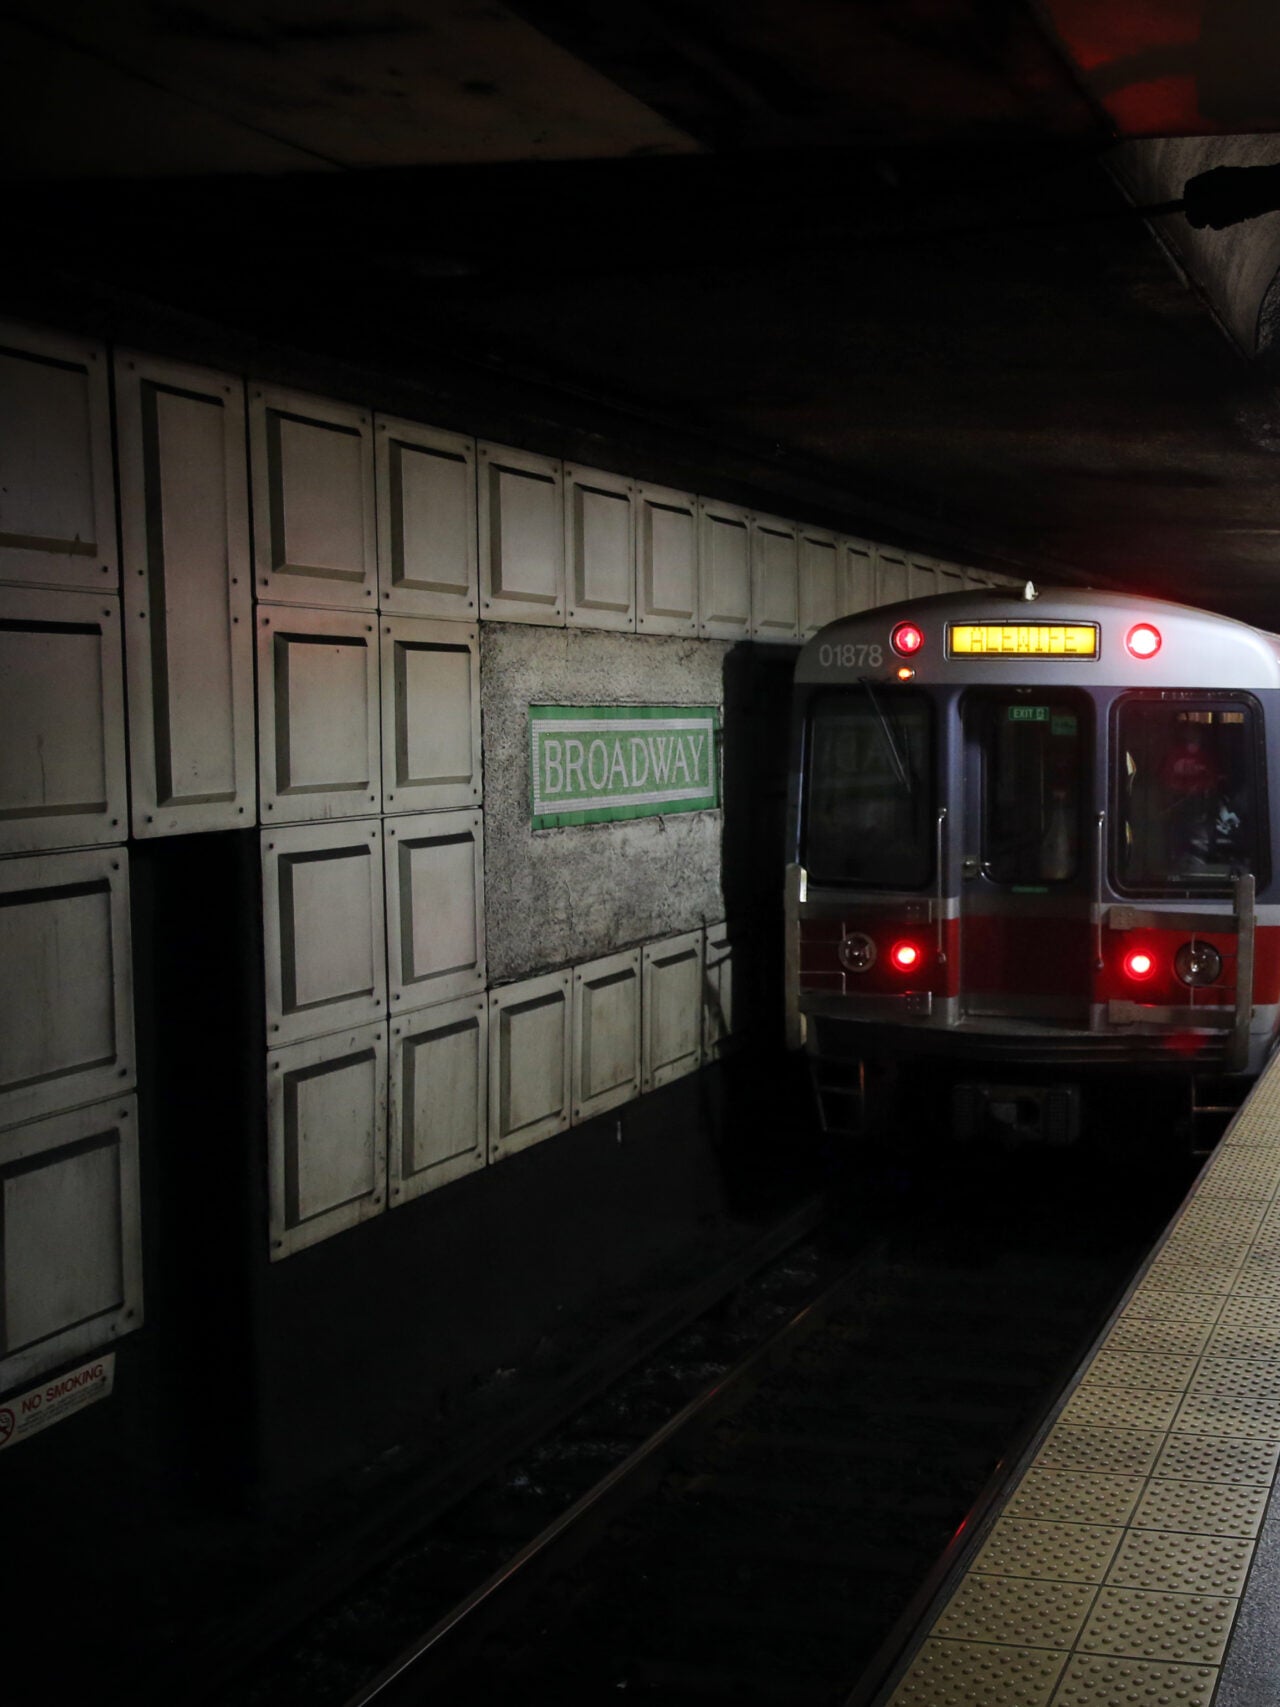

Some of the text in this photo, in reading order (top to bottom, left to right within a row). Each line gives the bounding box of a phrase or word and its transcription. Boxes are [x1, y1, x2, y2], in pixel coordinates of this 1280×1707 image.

[970, 626, 1077, 652] ALEWIFE
[819, 644, 883, 668] 01878
[1013, 709, 1034, 720] EXIT
[544, 736, 705, 794] BROADWAY
[22, 1395, 42, 1414] NO
[46, 1364, 103, 1402] SMOKING
